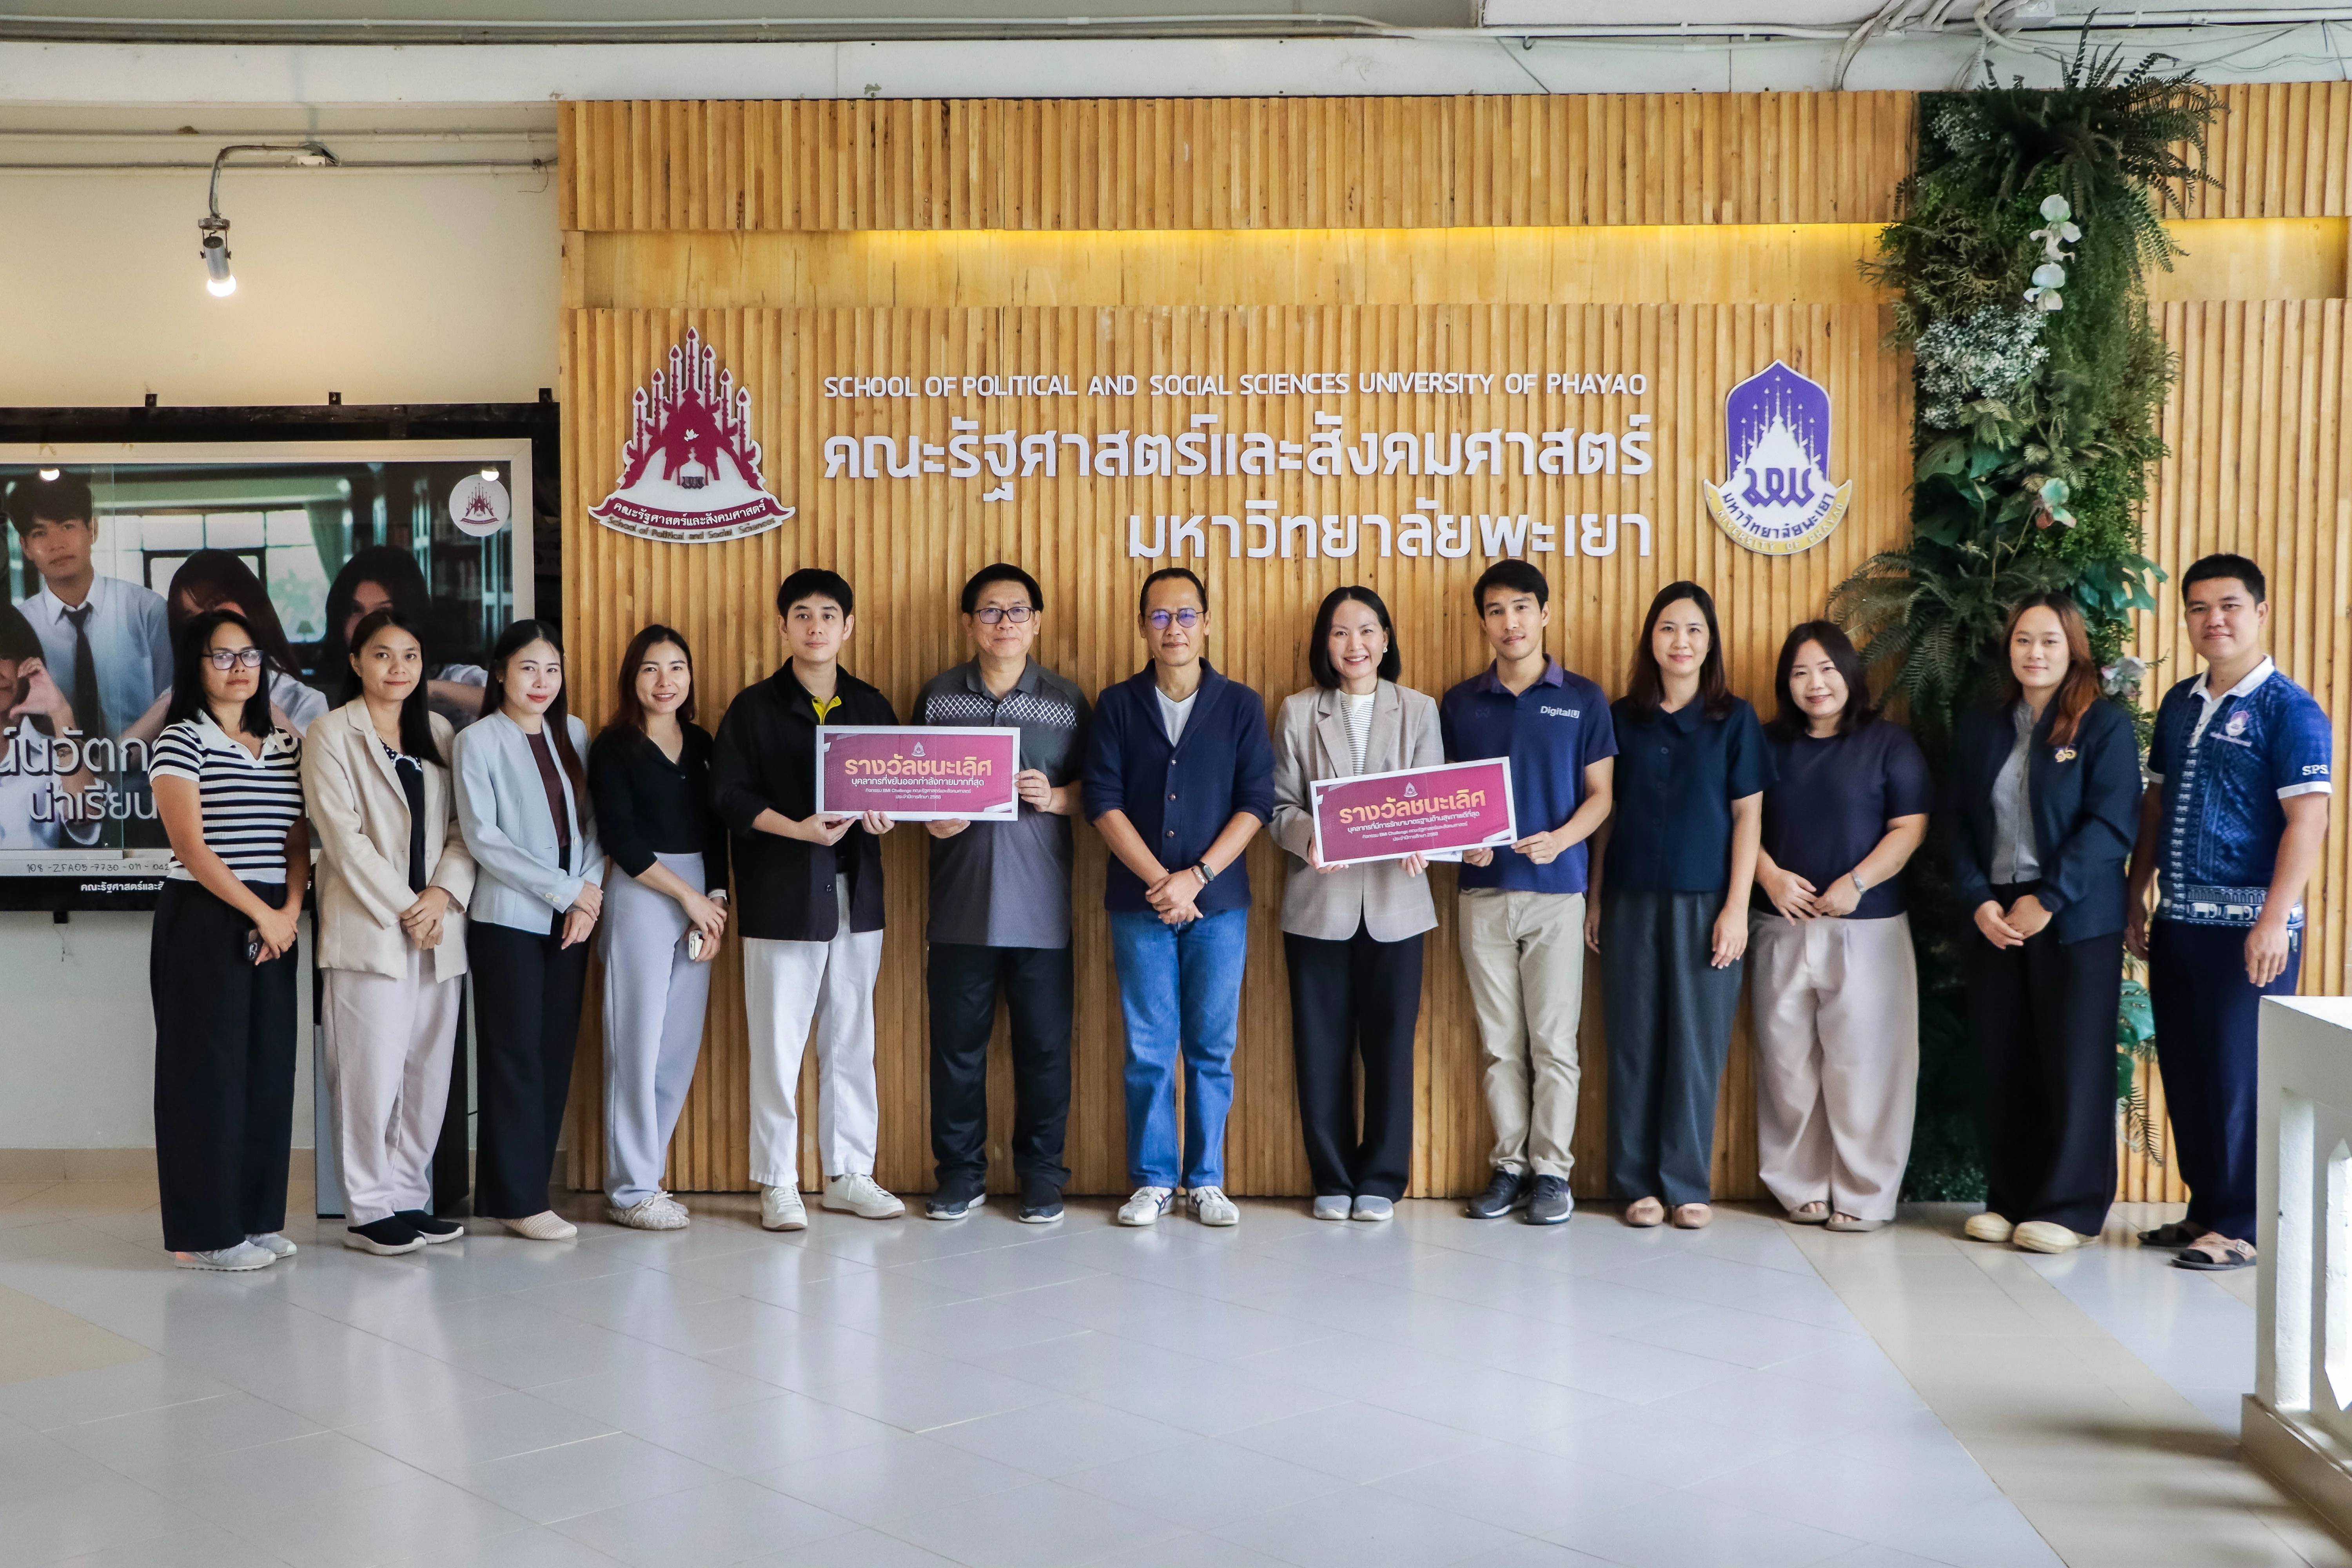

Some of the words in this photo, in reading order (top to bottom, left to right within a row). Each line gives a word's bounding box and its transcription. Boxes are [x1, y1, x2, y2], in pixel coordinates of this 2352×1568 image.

[824, 376, 918, 397] SCHOOL
[926, 376, 956, 397] OF
[963, 375, 1078, 396] POLITICAL
[1087, 375, 1137, 396] AND
[1149, 375, 1232, 396] SOCIAL
[1240, 373, 1350, 395] SCIENCES
[1359, 372, 1495, 394] UNIVERSITY
[1504, 373, 1537, 394] OF
[1546, 373, 1647, 395] PHAYAO
[824, 411, 1652, 501] คณะรัฐศาสตร์และสังคมศาสตร์
[613, 499, 766, 526] คณะรัฐศาสตร์และสังคมศาสตร์
[1722, 492, 1835, 539] มหาวิทยาลัยพะเยา
[608, 516, 637, 532] School
[651, 529, 684, 540] Political
[688, 531, 704, 540] and
[708, 529, 733, 539] Social
[739, 517, 776, 534] Sciences
[1129, 497, 1650, 557] มหาวิทยาลัยพะเยา
[845, 753, 992, 776] รางวัลชนะเลิศ
[2302, 764, 2328, 776] SPS
[851, 775, 984, 787] บุคลากรที่ขยันออกกำลังกายมากที่สุด
[1339, 788, 1486, 824] รางวัลชนะเลิศ
